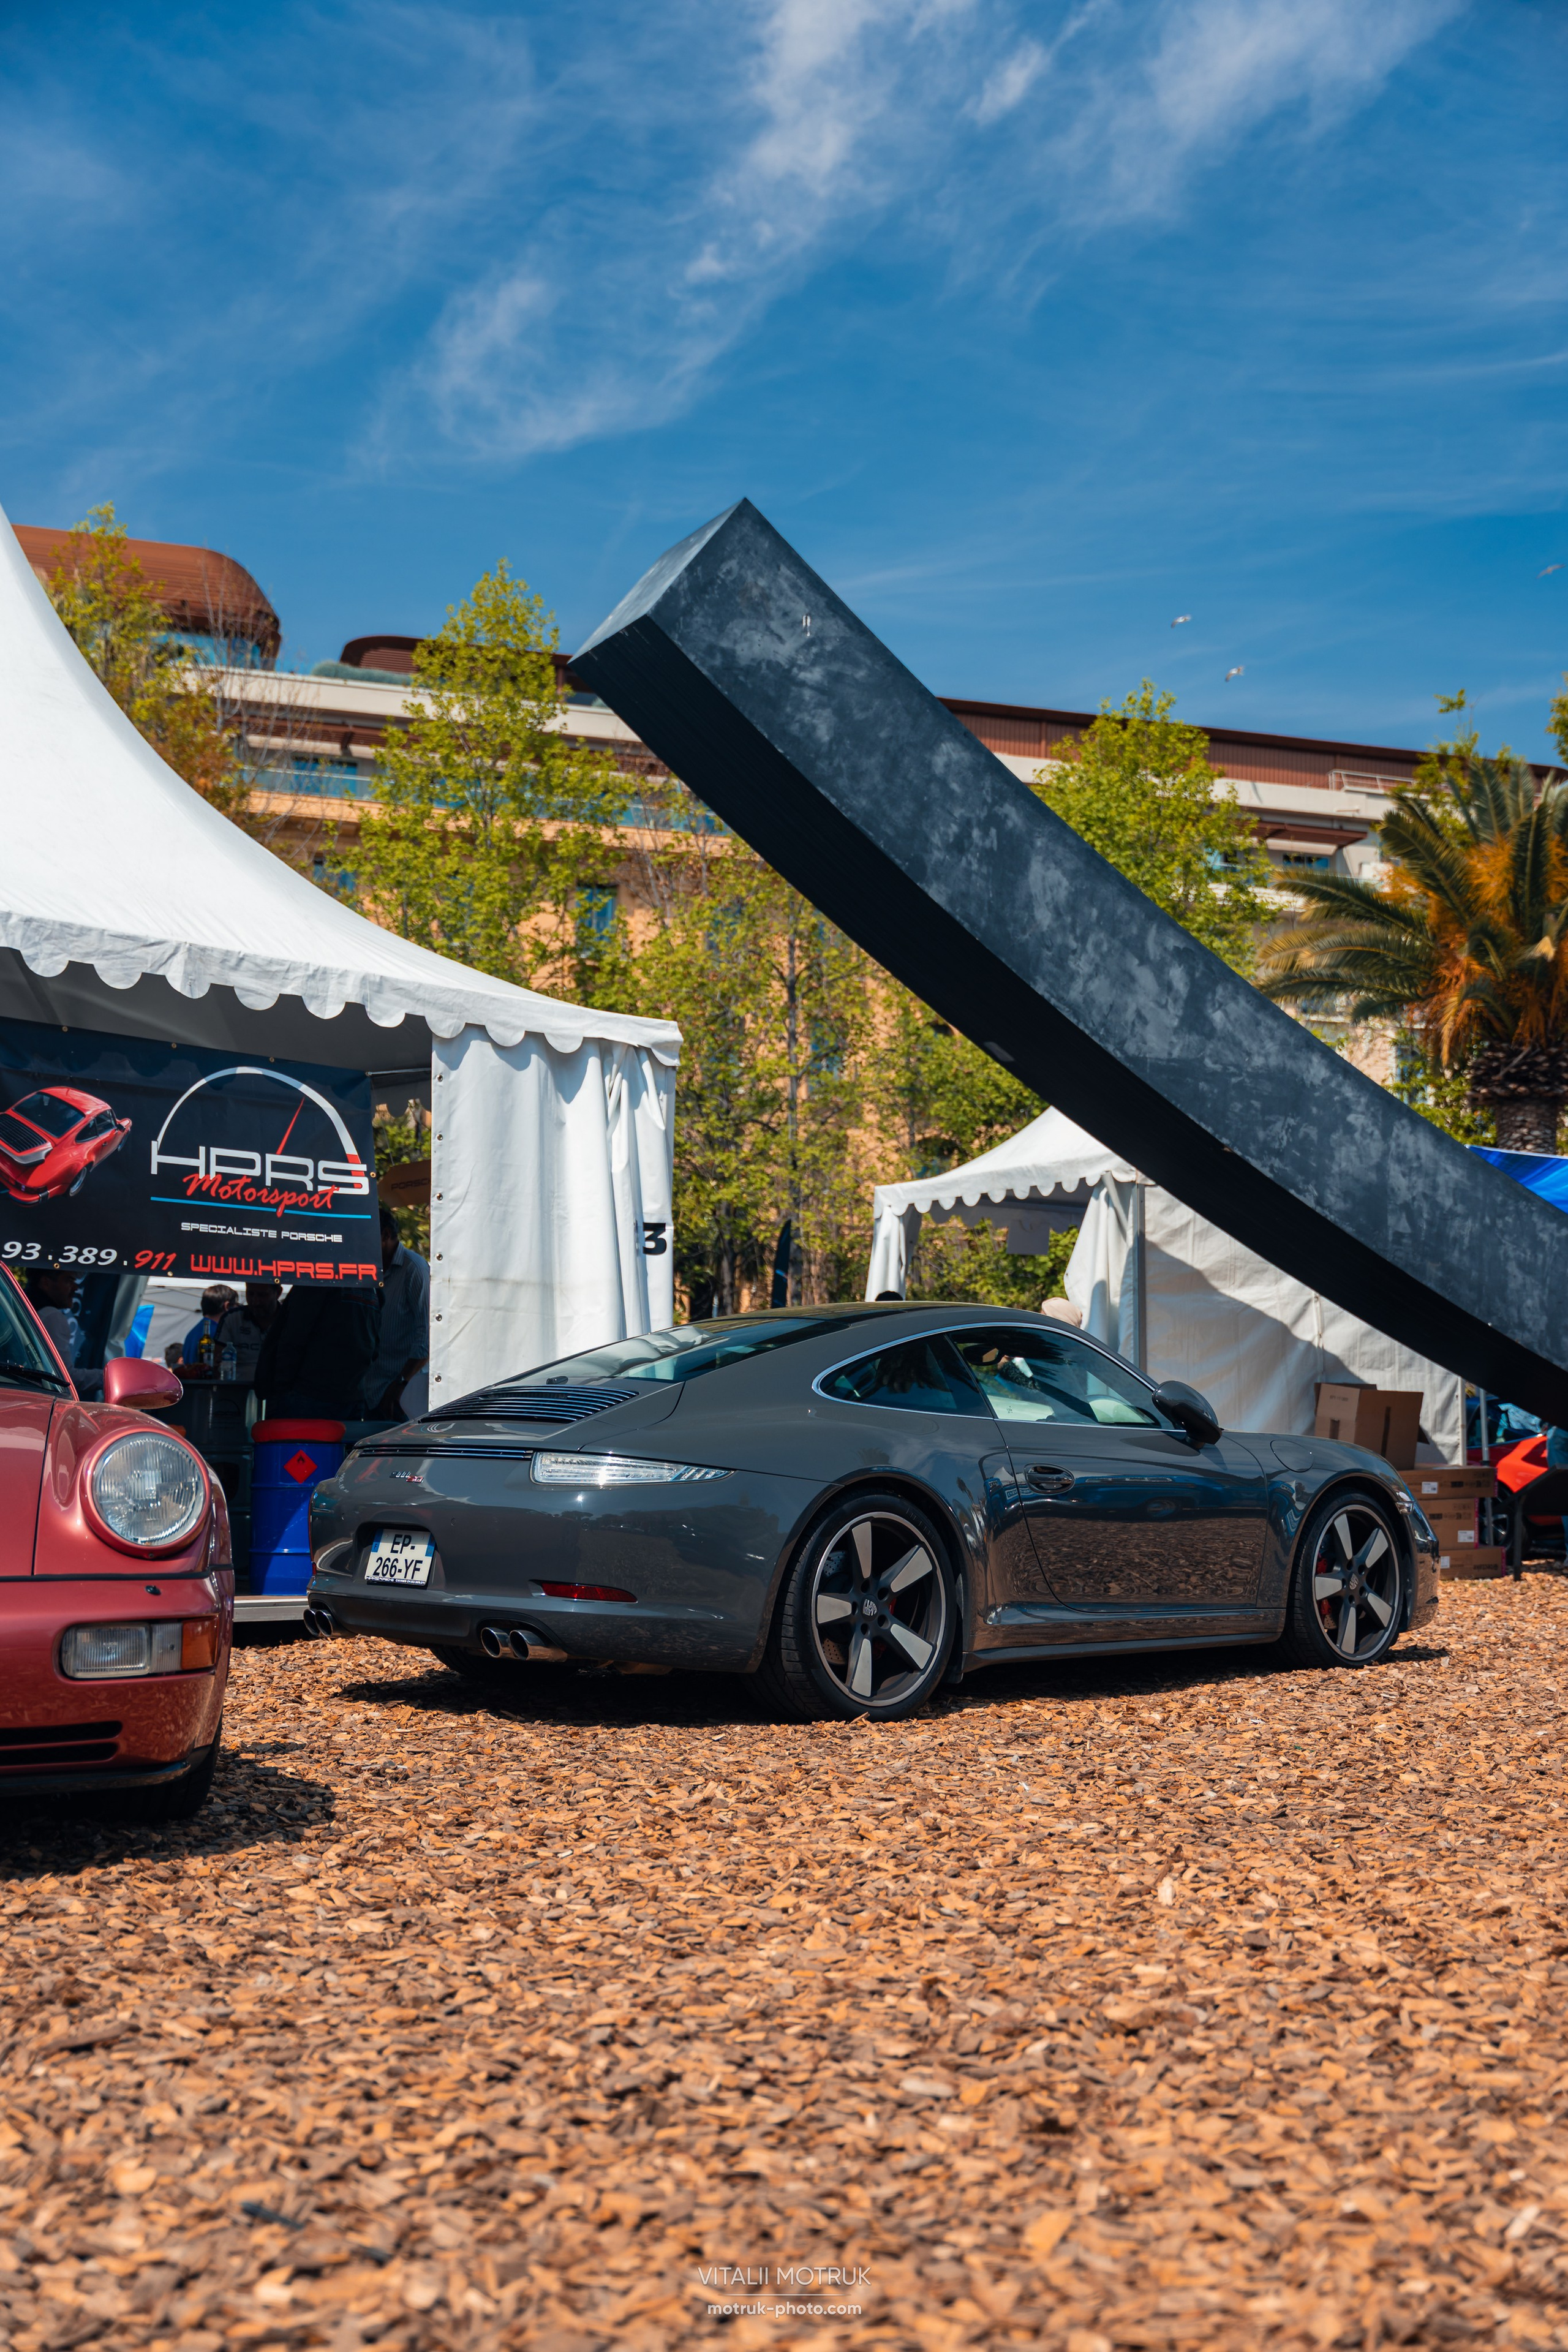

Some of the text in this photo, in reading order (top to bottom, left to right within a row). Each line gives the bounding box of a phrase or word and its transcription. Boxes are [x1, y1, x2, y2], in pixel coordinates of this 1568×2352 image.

[151, 1140, 370, 1195] HPRS
[183, 1172, 340, 1218] Motorsport
[181, 1222, 343, 1243] SPECIALISTE PORSCHE
[190, 1254, 377, 1281] WWW.HPRS.FR
[390, 1534, 415, 1554] EP-
[372, 1556, 423, 1580] 266-YF
